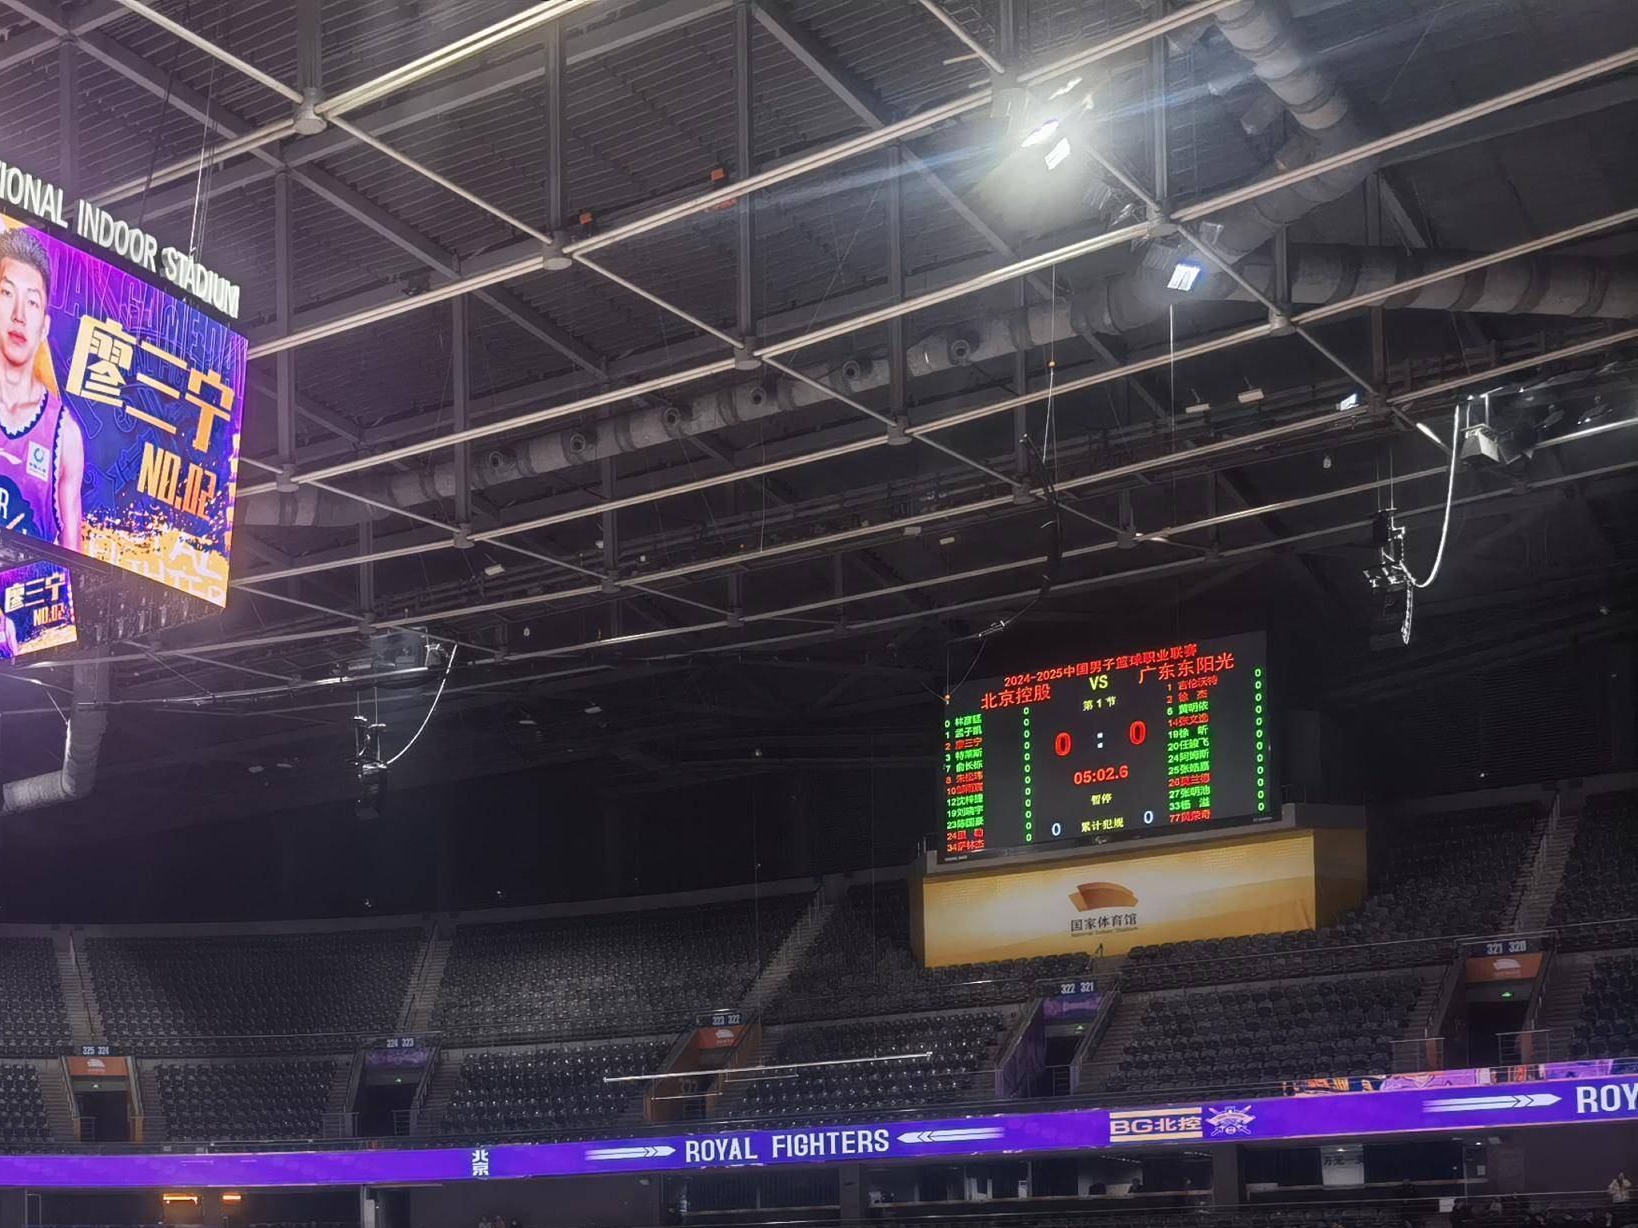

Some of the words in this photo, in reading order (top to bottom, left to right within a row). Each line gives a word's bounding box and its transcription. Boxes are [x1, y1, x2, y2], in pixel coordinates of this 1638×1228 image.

[76, 200, 158, 272] INDOOR
[162, 247, 241, 319] STADIUM
[66, 313, 235, 452] 廖三宁
[137, 441, 217, 521] NO.02
[1138, 652, 1235, 684] 广东东阳光
[1089, 674, 1108, 691] VS
[981, 683, 1051, 710] 北京控股
[1055, 732, 1072, 756] 0
[1129, 720, 1146, 744] 0
[1073, 765, 1129, 784] 05:02.6
[1091, 793, 1112, 806] 暂停
[1081, 817, 1124, 833] 累计犯规
[1143, 810, 1154, 824] 0
[1052, 823, 1061, 836] 0
[1071, 913, 1137, 931] 国家体育馆
[1487, 941, 1503, 954] 321
[1061, 983, 1076, 994] 322
[1080, 981, 1094, 992] 321
[1109, 1115, 1202, 1136] BG北控
[684, 1134, 757, 1164] ROYAL
[772, 1129, 890, 1157] FIGHTERS
[471, 1149, 490, 1177] 北京
